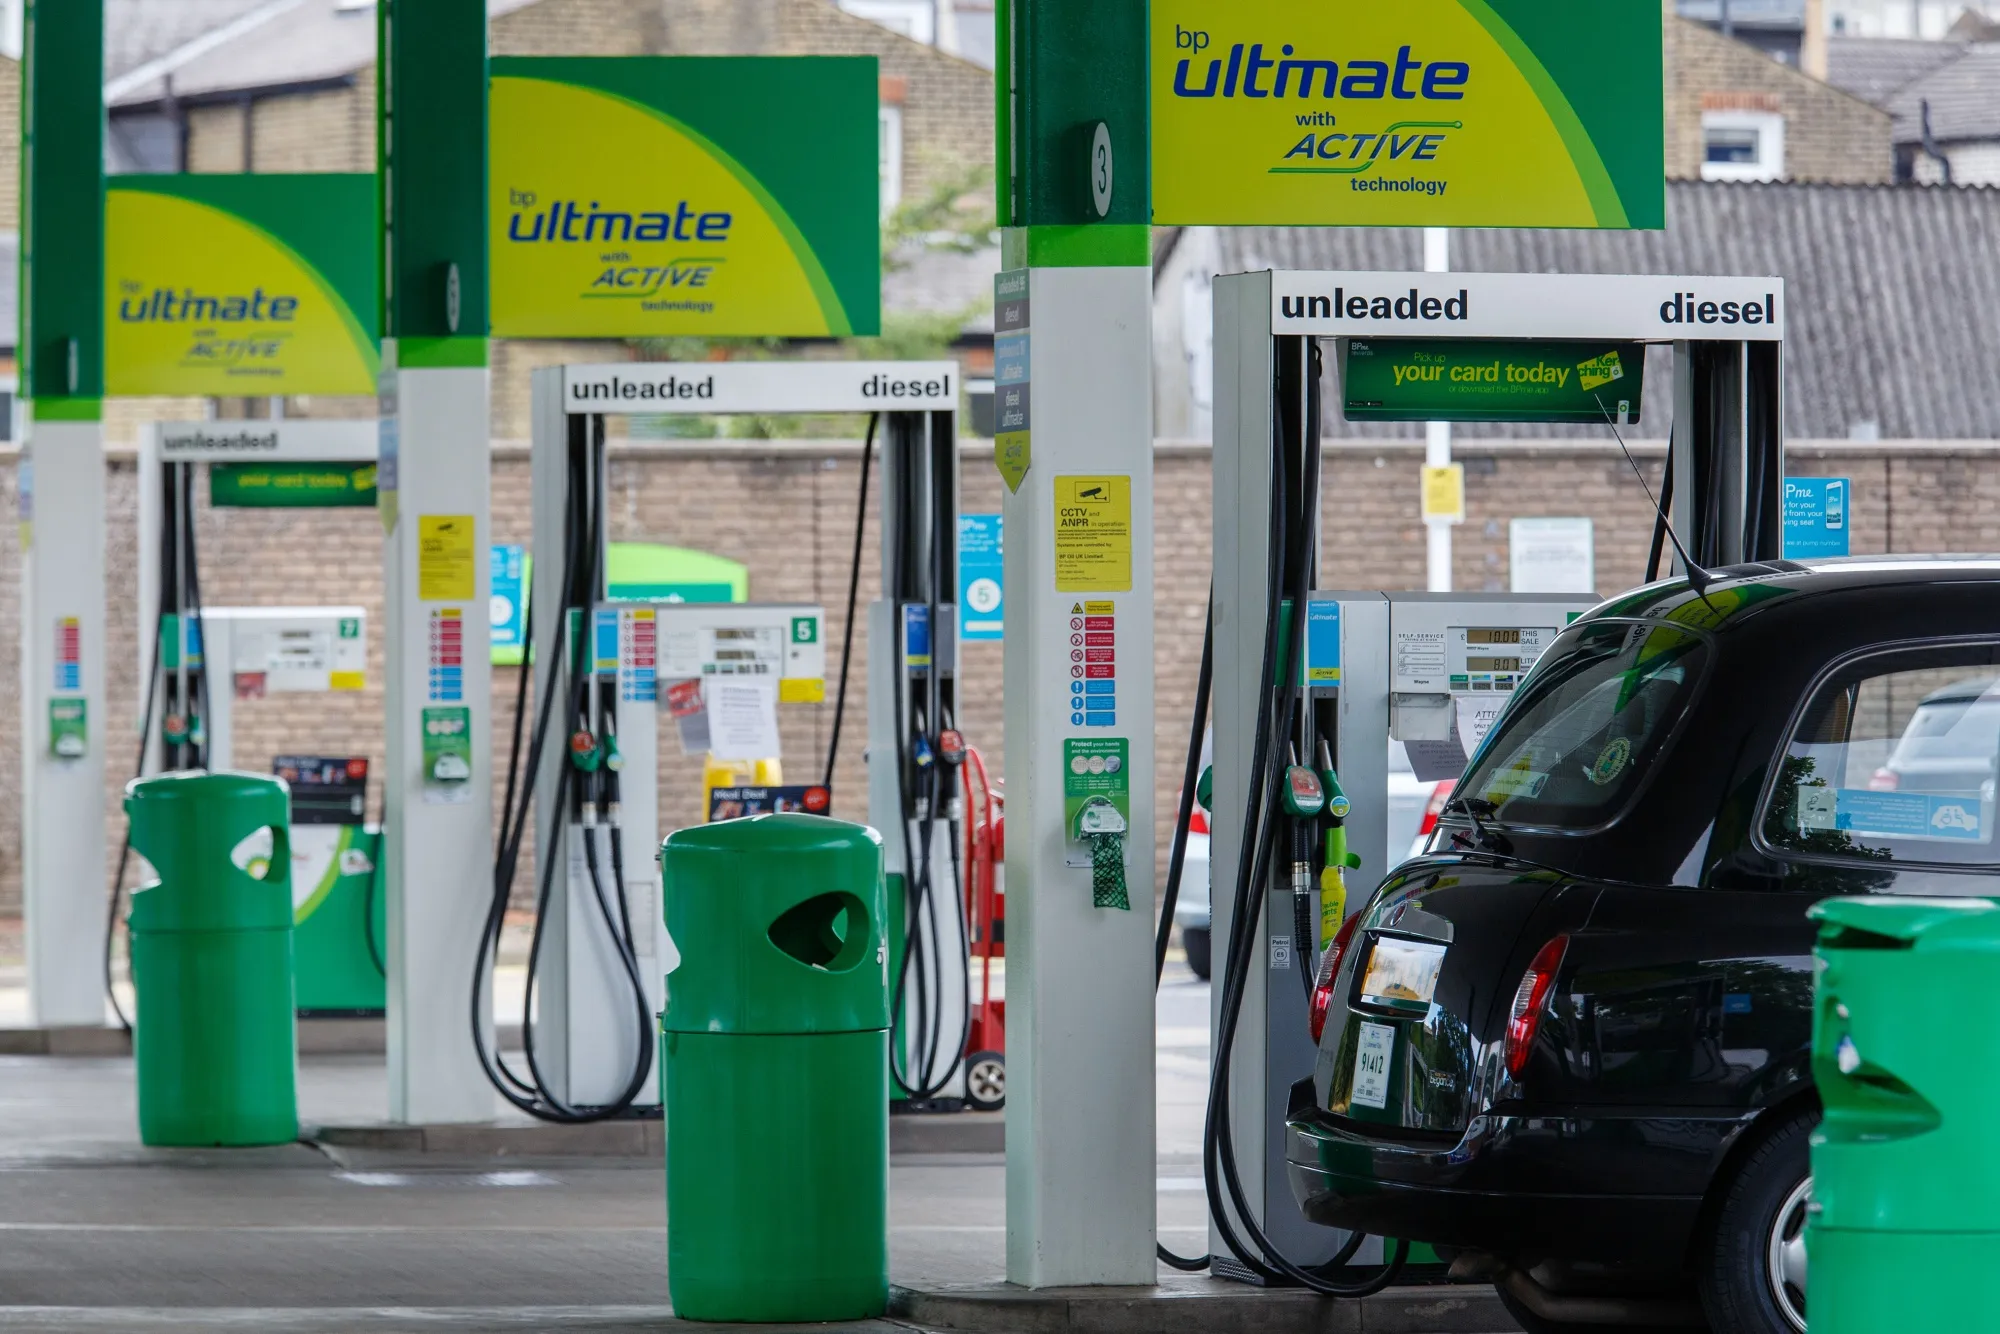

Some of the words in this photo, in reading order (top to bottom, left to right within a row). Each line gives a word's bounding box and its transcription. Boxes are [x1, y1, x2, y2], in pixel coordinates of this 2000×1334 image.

[1176, 25, 1210, 54] bp
[1173, 43, 1470, 100] ultimate
[1295, 112, 1336, 127] with
[1283, 133, 1446, 161] ACTIVE
[1098, 144, 1106, 194] 3
[1350, 177, 1447, 195] technology
[509, 187, 537, 208] bp
[508, 201, 732, 242] ultimate
[601, 252, 631, 262] with
[592, 267, 714, 288] ACTIVE
[119, 288, 299, 323] ultimate
[641, 300, 714, 312] technology
[1281, 287, 1468, 320] unleaded
[1659, 293, 1775, 325] diesel
[187, 340, 282, 358] ACTIVE
[1414, 352, 1432, 362] Pick
[1434, 354, 1446, 364] up
[1393, 364, 1445, 386] your
[1450, 361, 1499, 382] card
[1505, 362, 1571, 388] today
[1579, 365, 1610, 379] ching
[573, 376, 714, 400] unleaded
[862, 374, 950, 399] diesel
[1458, 385, 1495, 394] download
[1496, 385, 1508, 394] the
[1510, 385, 1533, 394] BPme
[164, 431, 278, 450] unleaded
[1785, 484, 1814, 498] Pme
[1060, 508, 1087, 517] CCTV
[1788, 509, 1805, 517] from
[1061, 518, 1089, 527] ANPR
[796, 620, 811, 640] 5
[1489, 630, 1518, 643] 10.00
[1494, 658, 1518, 671] 8.07
[713, 788, 738, 800] Meal
[742, 788, 767, 799] Deal
[1361, 1053, 1384, 1074] 91412
